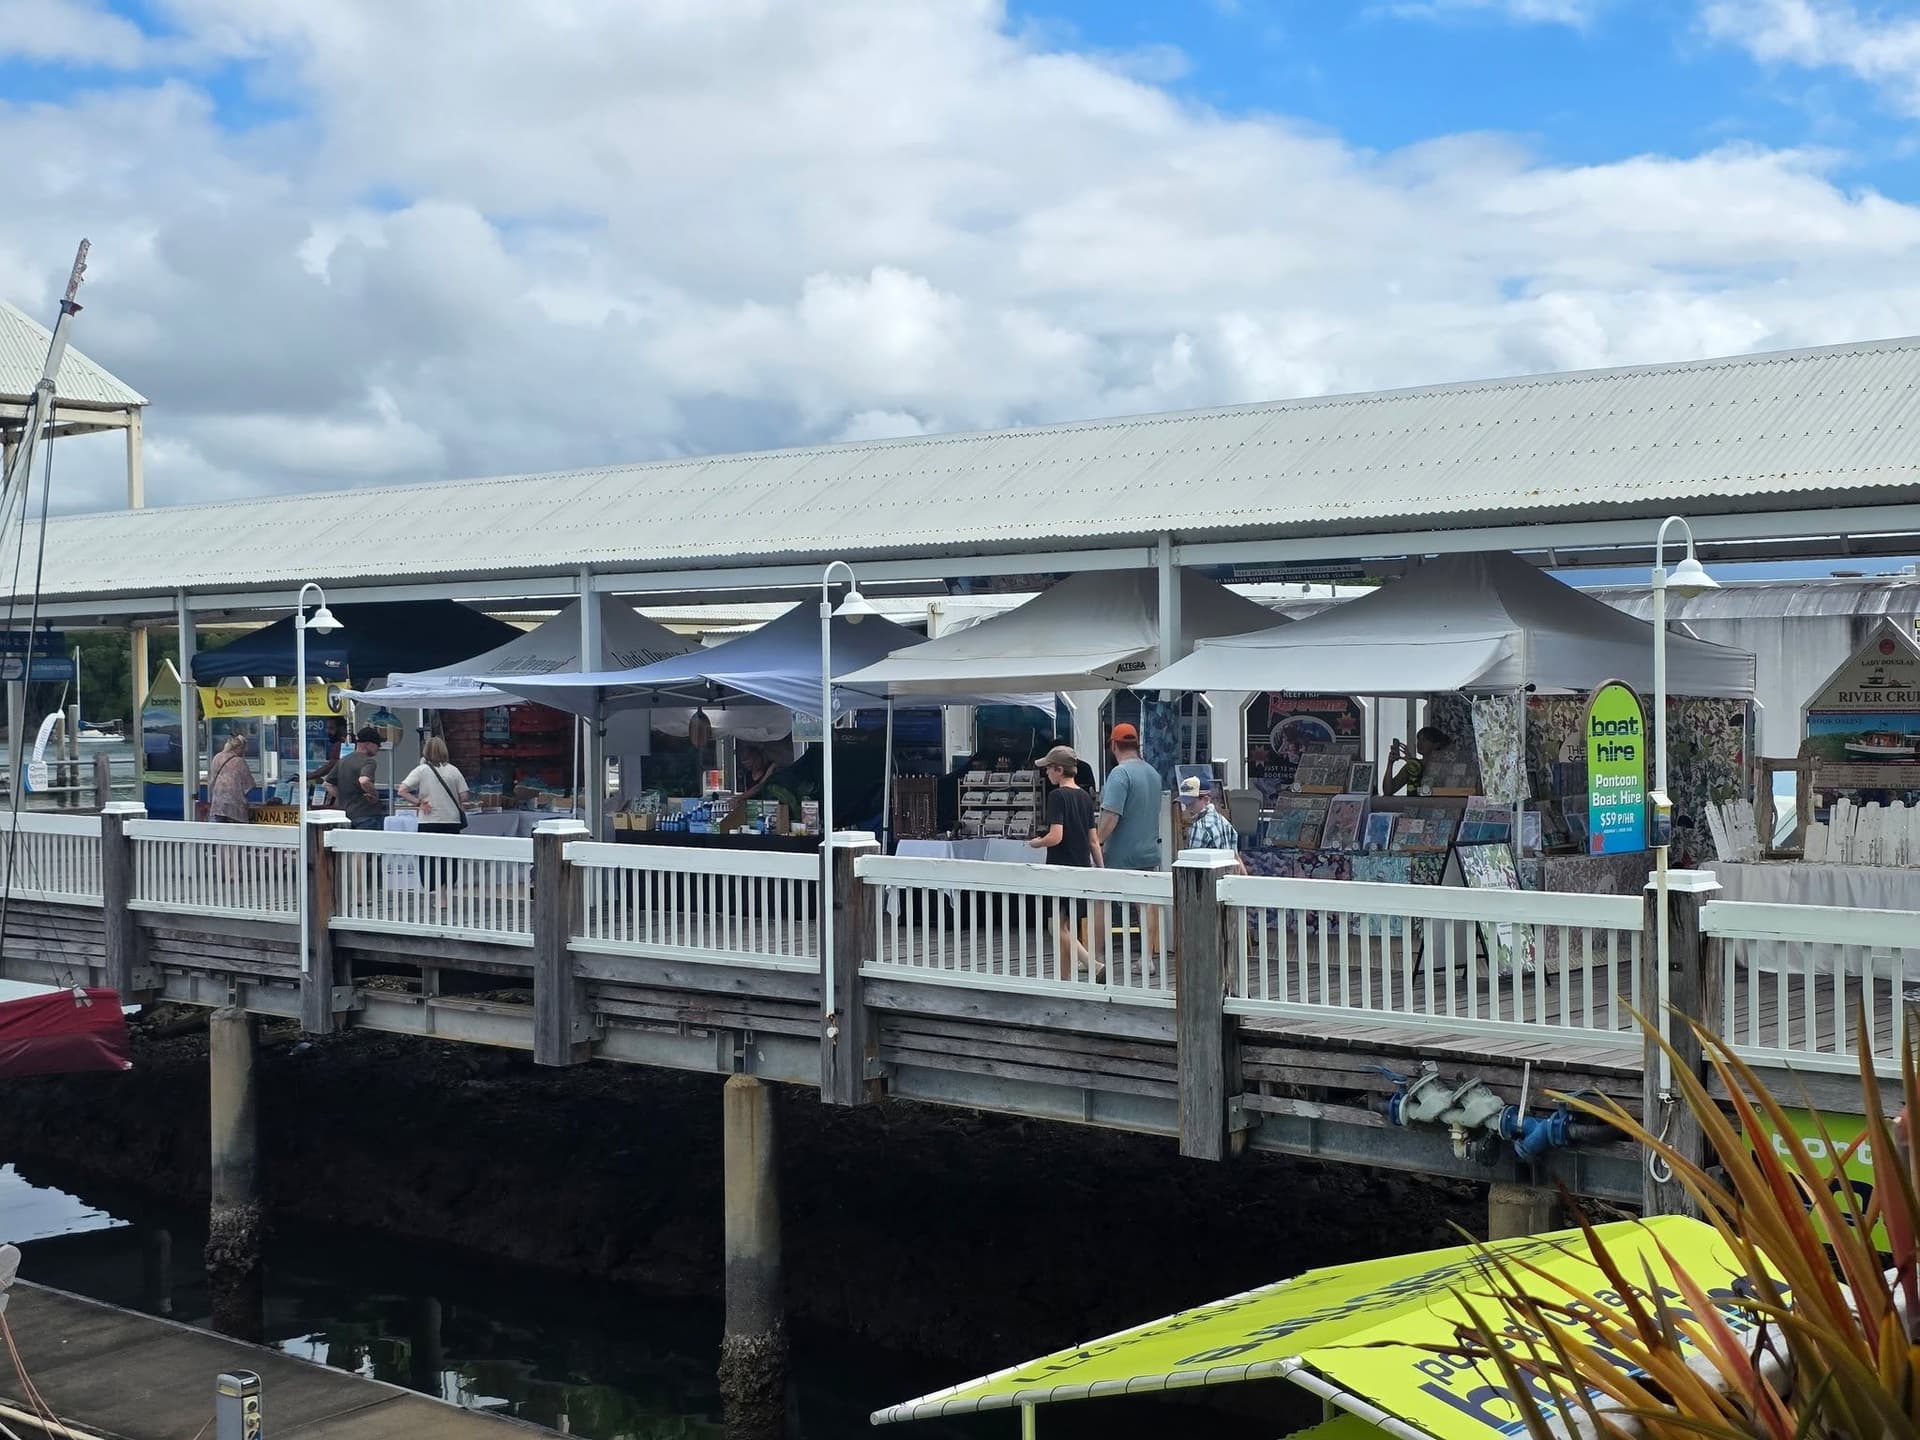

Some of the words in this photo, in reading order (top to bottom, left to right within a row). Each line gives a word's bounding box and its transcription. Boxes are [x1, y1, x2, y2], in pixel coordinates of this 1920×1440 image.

[1839, 691, 1883, 703] RIVER
[1886, 691, 1920, 703] CRUI
[291, 720, 324, 730] CYPSO
[1591, 715, 1639, 737] boat
[1566, 744, 1586, 756] THE
[1597, 740, 1635, 763] hire
[1595, 774, 1638, 789] Pontoon
[1592, 792, 1618, 807] Boat
[1620, 790, 1642, 804] Hire
[248, 807, 281, 824] ANANA
[283, 811, 299, 825] BRE
[1600, 812, 1617, 828] $59
